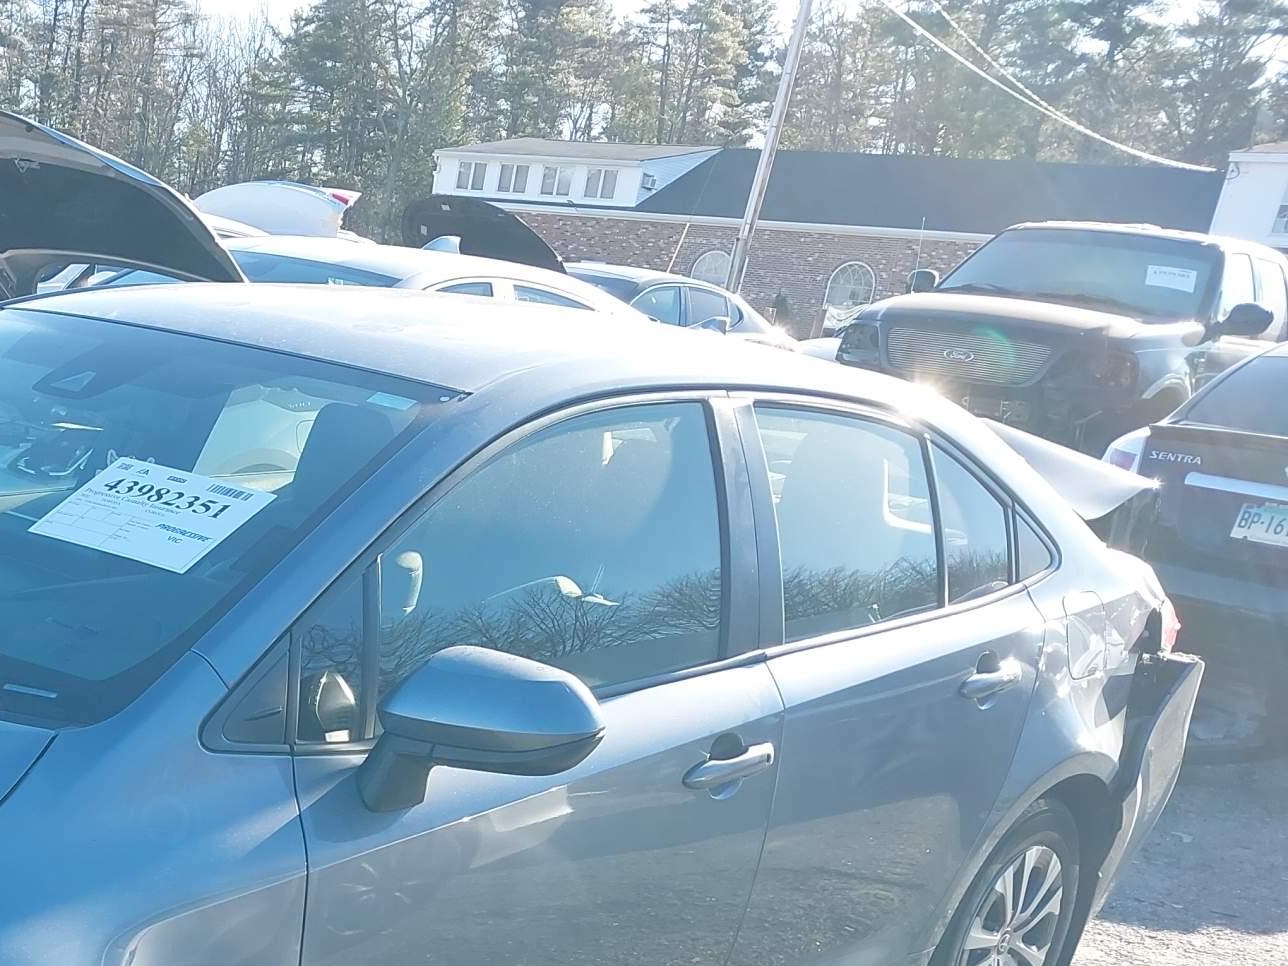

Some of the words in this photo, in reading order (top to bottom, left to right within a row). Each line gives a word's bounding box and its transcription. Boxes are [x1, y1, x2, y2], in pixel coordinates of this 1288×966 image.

[1149, 450, 1202, 465] SENTRA
[103, 477, 231, 519] 43982351
[155, 523, 214, 542] PROGRESSIVE
[167, 535, 185, 544] VIC
